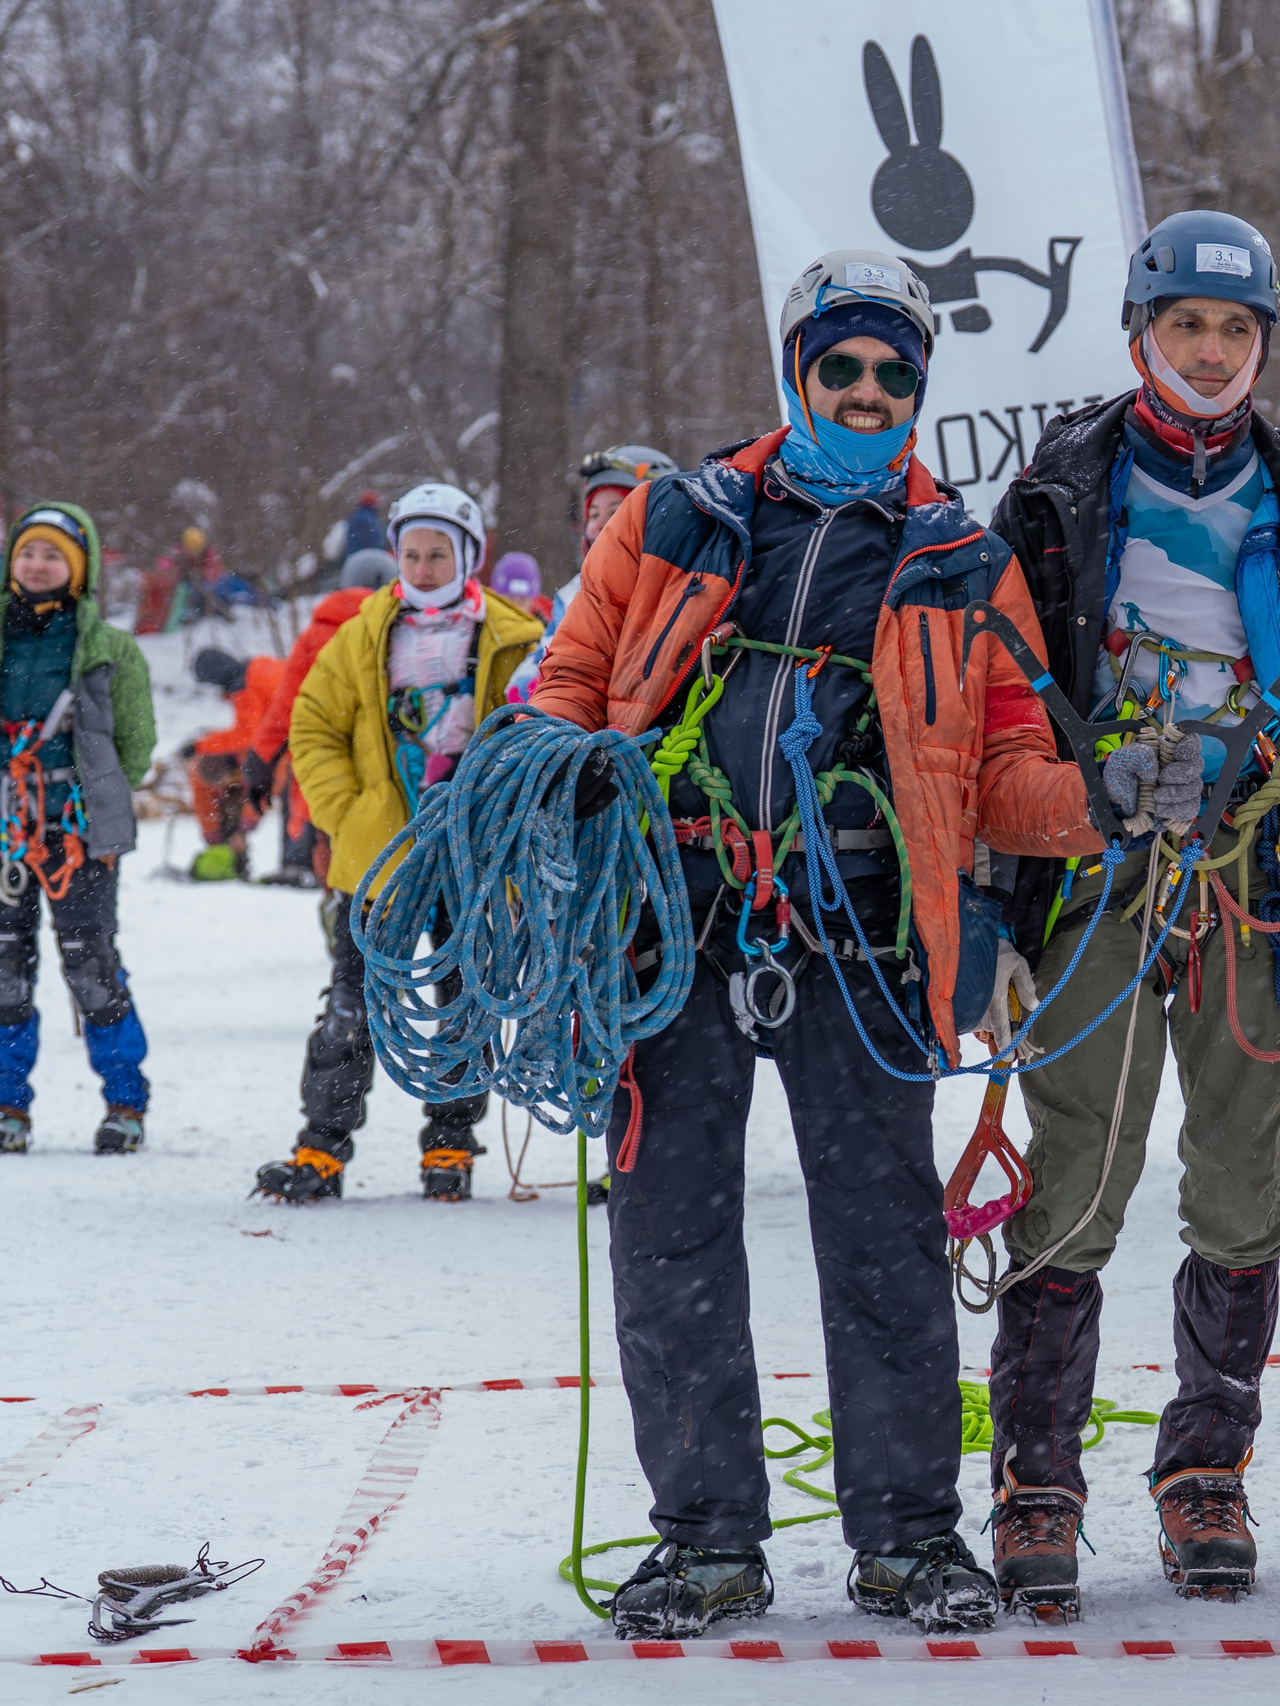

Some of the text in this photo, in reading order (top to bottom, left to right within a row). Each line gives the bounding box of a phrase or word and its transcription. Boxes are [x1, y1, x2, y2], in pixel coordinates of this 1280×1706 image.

[1215, 250, 1233, 262] 3.1
[864, 267, 885, 279] 3.3
[1231, 1268, 1262, 1277] SPLAV
